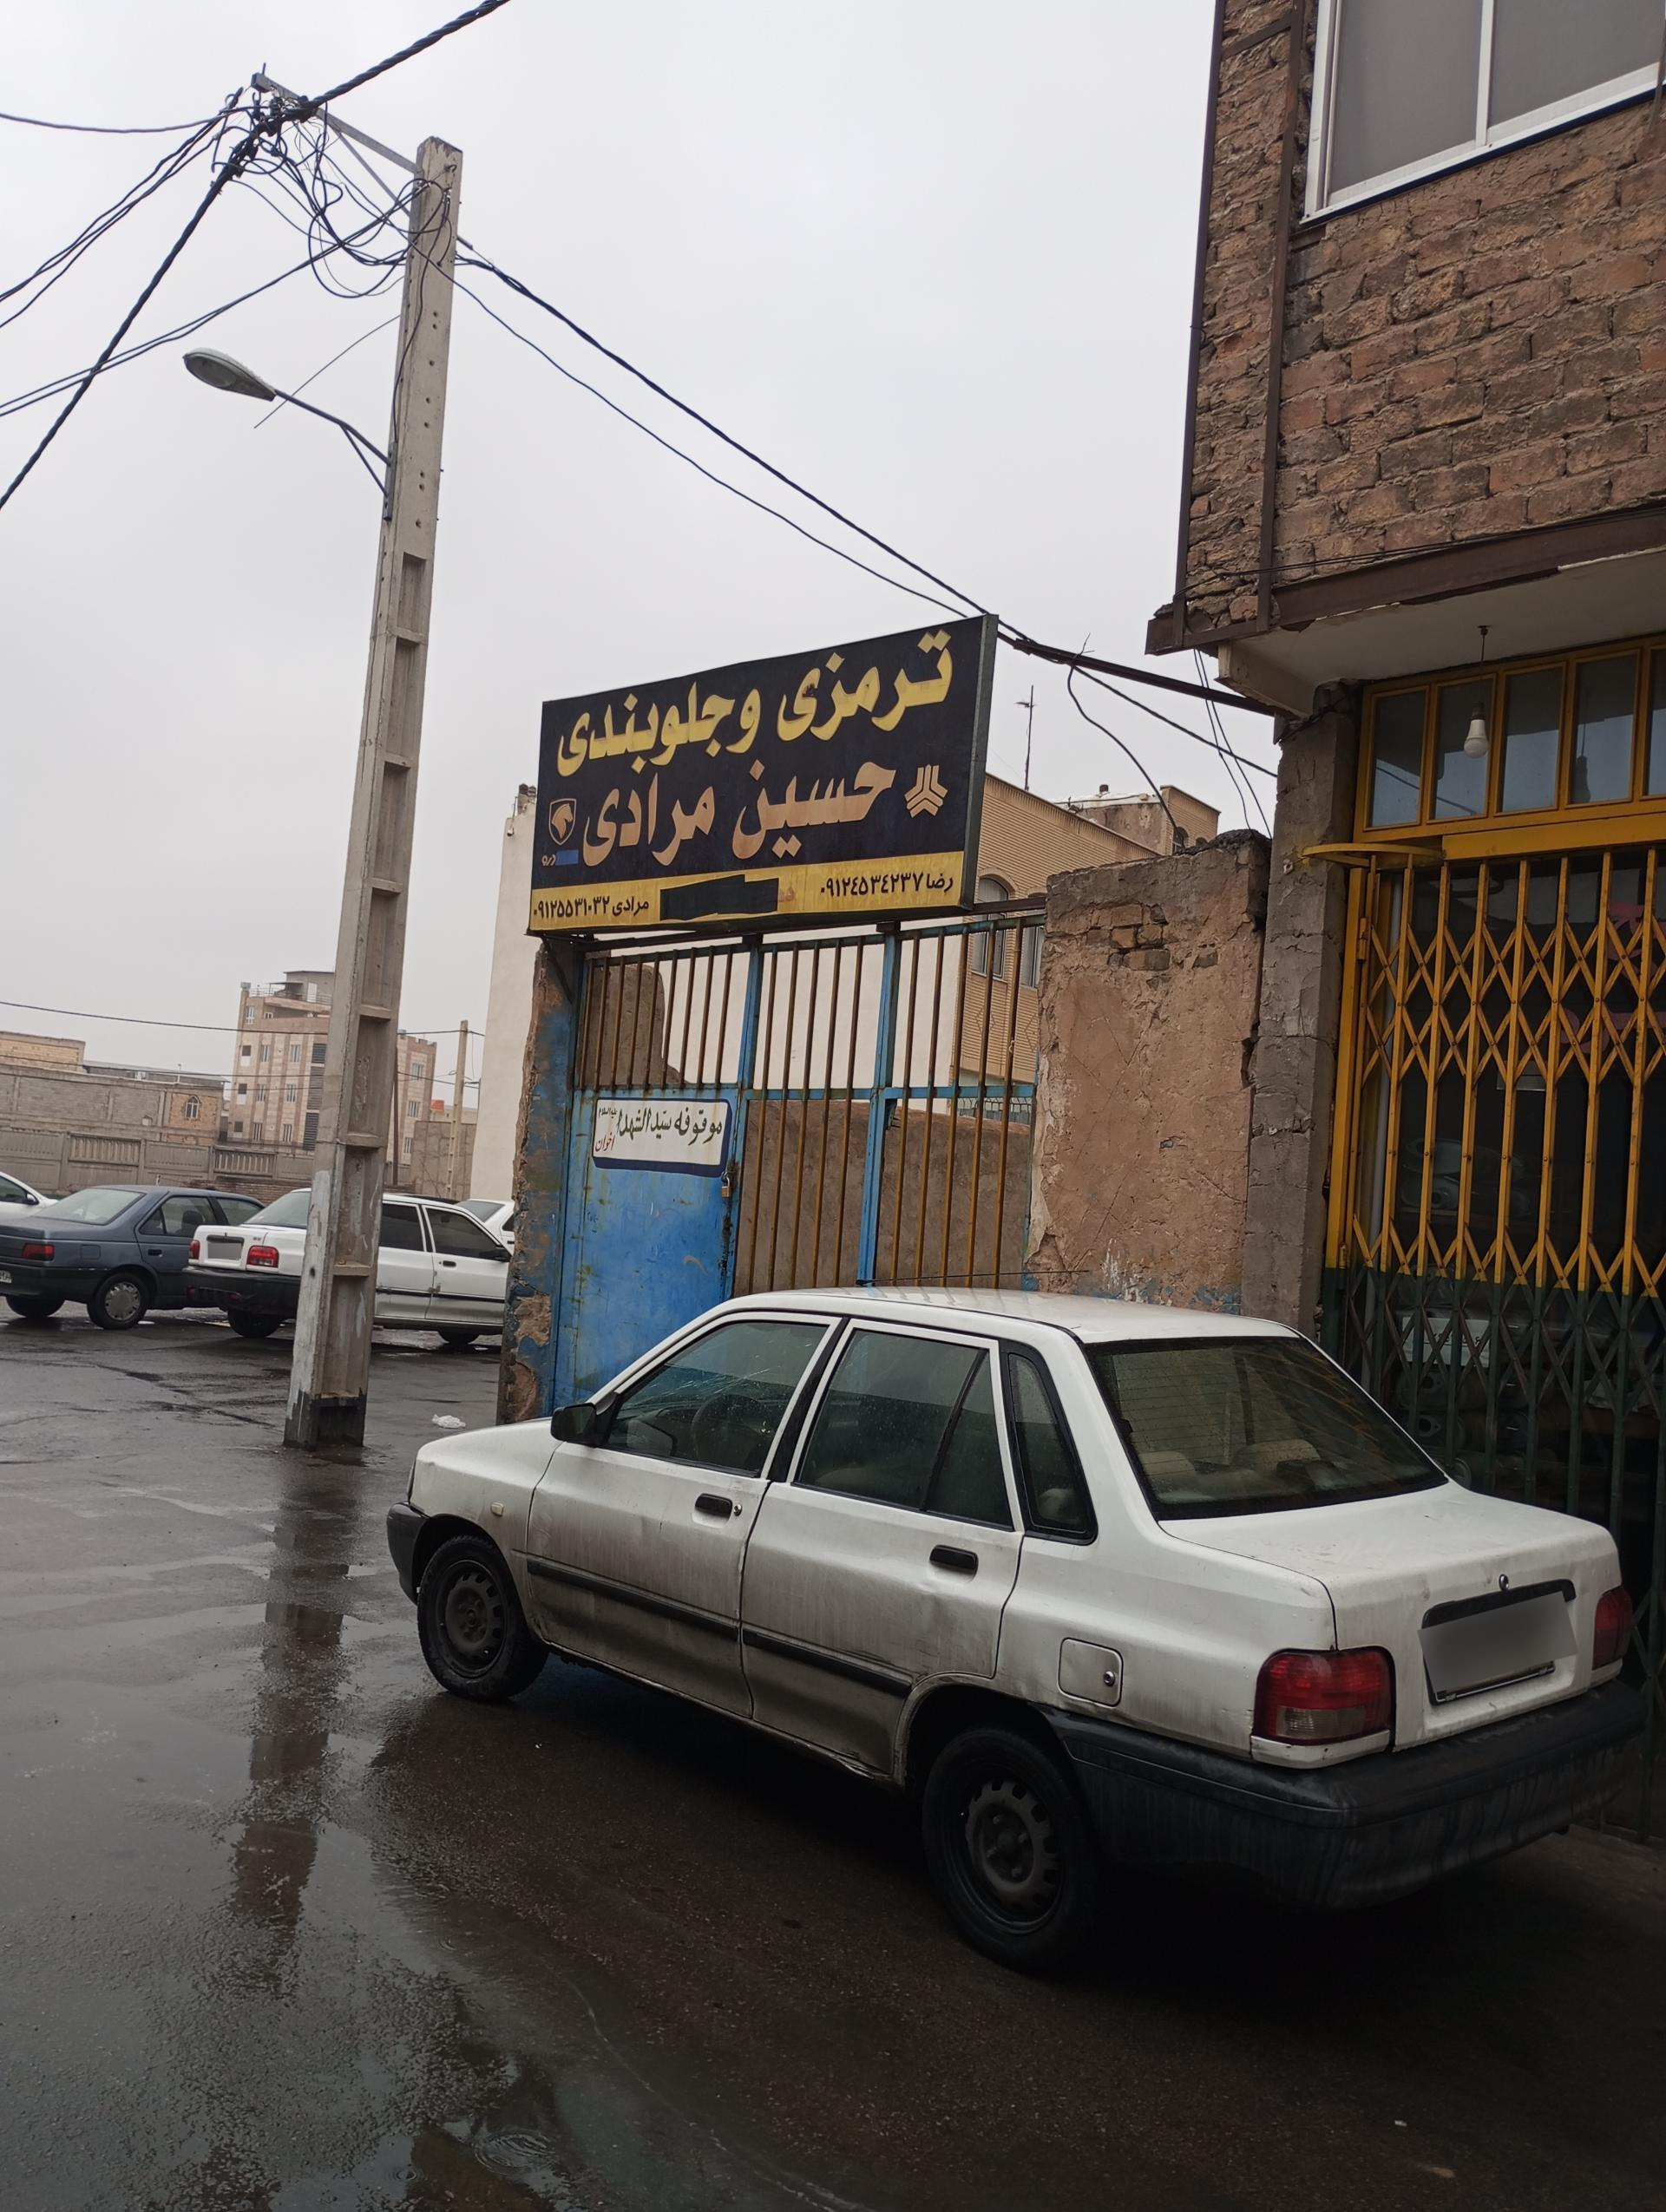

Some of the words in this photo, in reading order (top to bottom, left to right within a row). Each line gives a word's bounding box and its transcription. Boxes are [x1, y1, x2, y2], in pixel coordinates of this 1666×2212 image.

[777, 629, 953, 741] ترمزی
[582, 772, 715, 867] مرادی
[731, 759, 895, 860] حسین
[612, 896, 649, 916] مرادی
[926, 873, 953, 893] رضا
